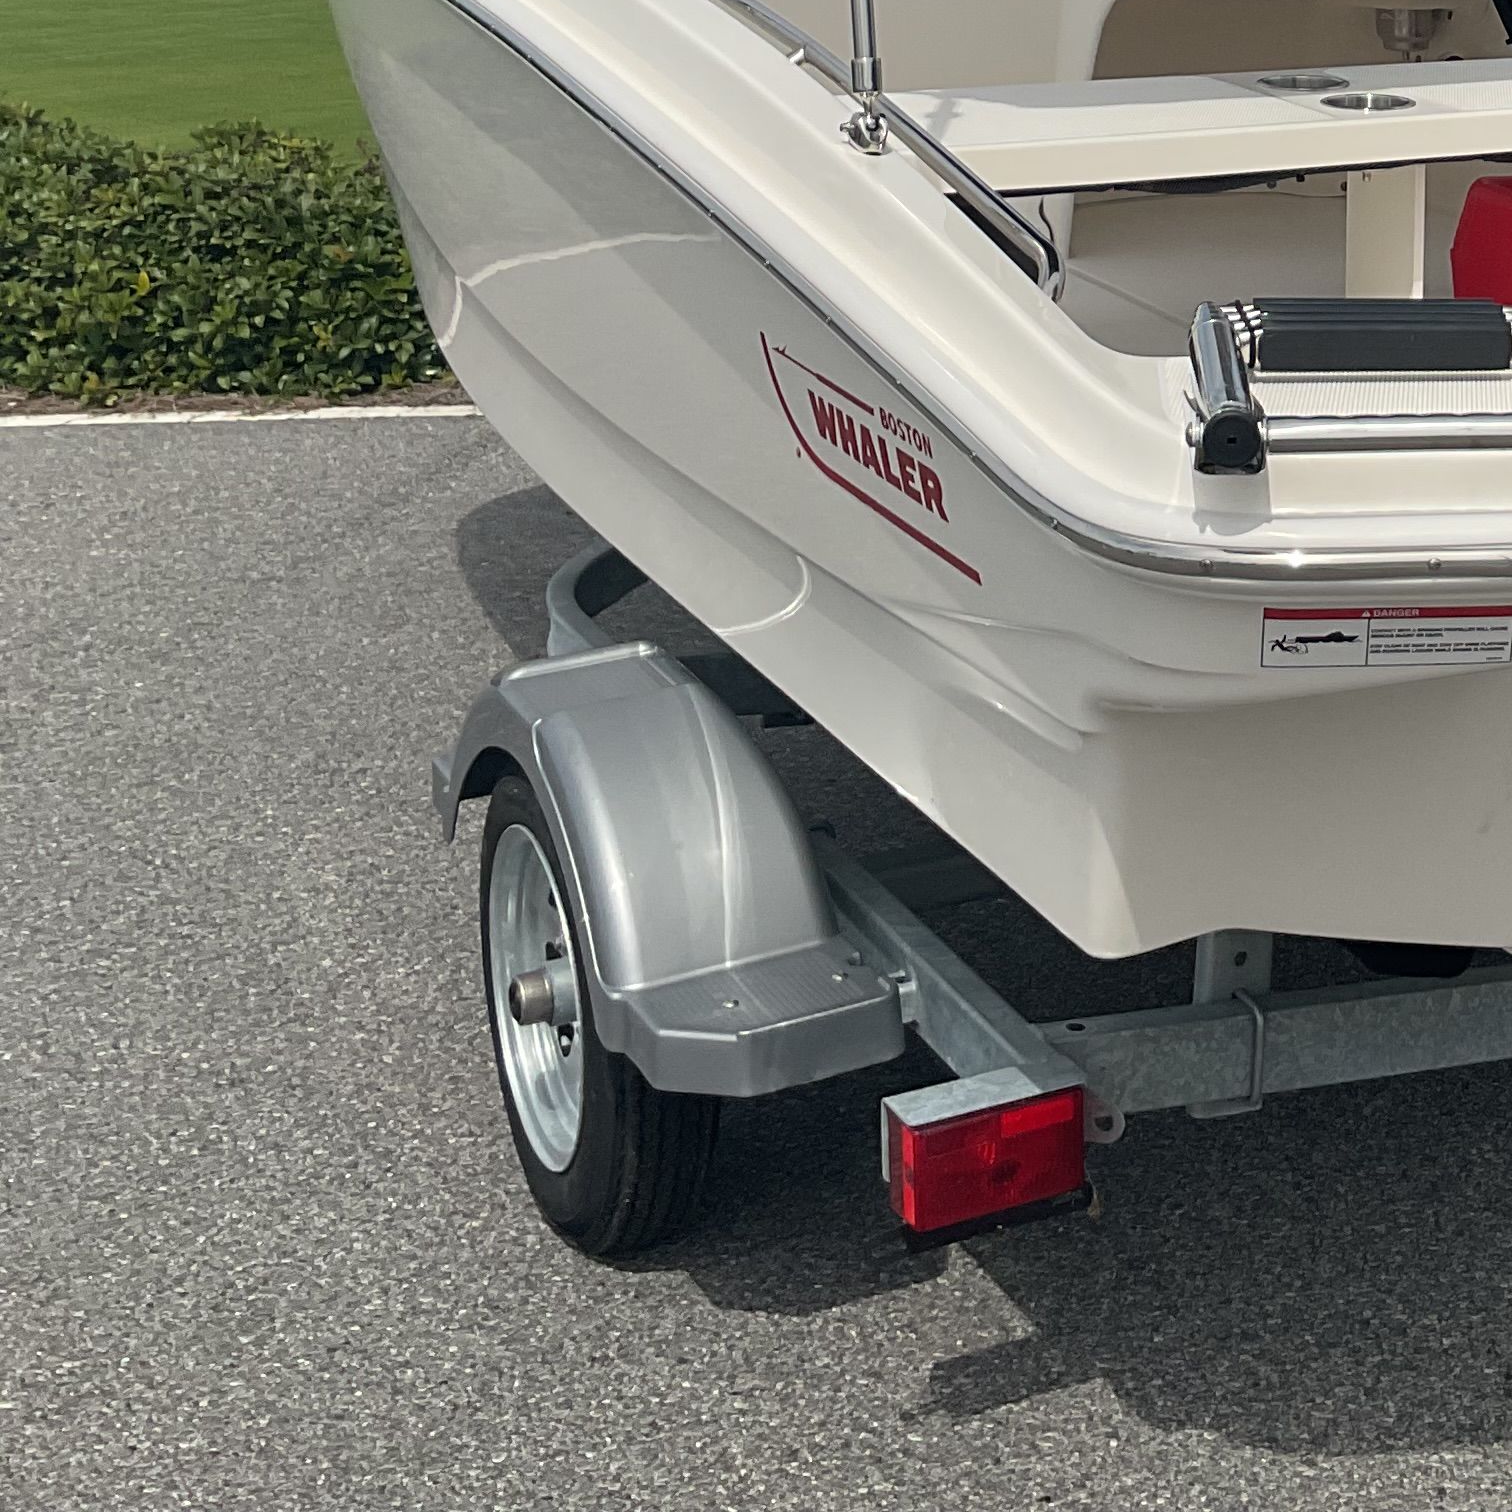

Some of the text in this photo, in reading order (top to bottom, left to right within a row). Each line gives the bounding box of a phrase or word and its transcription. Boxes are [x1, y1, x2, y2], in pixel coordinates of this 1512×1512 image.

[807, 388, 950, 523] WHALER
[879, 406, 934, 459] BOSTON
[1373, 608, 1420, 618] DANGER
